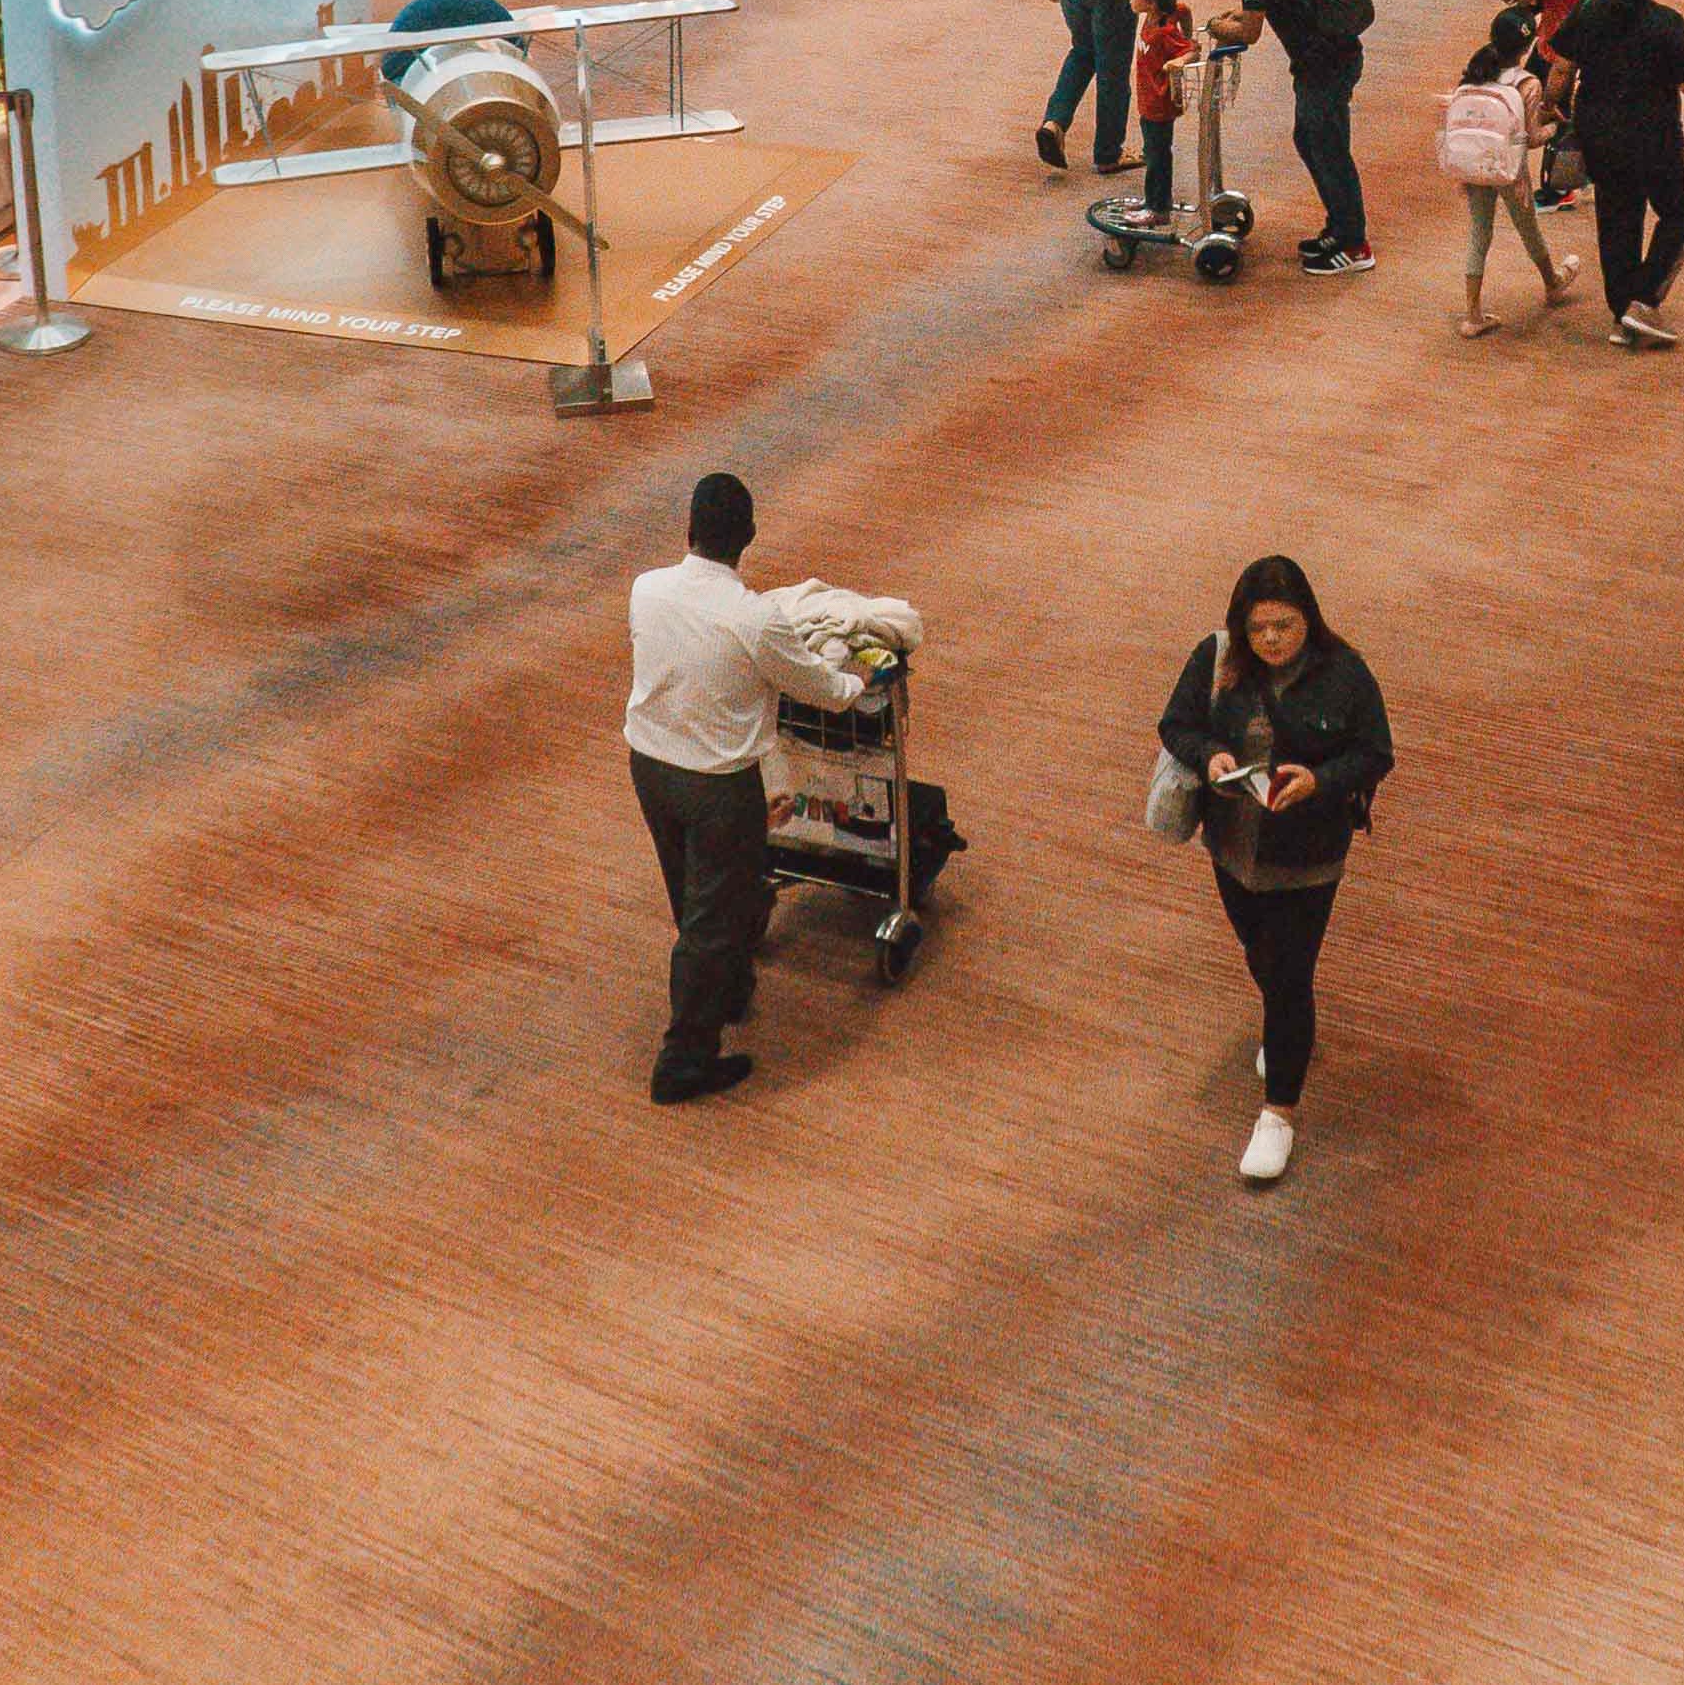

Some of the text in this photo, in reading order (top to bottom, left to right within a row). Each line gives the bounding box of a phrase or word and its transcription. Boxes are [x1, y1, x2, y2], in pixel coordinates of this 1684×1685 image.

[650, 194, 788, 303] PLEASE MIND YOUR STEP
[179, 296, 463, 341] PLEASE MIND YOUR STEP
